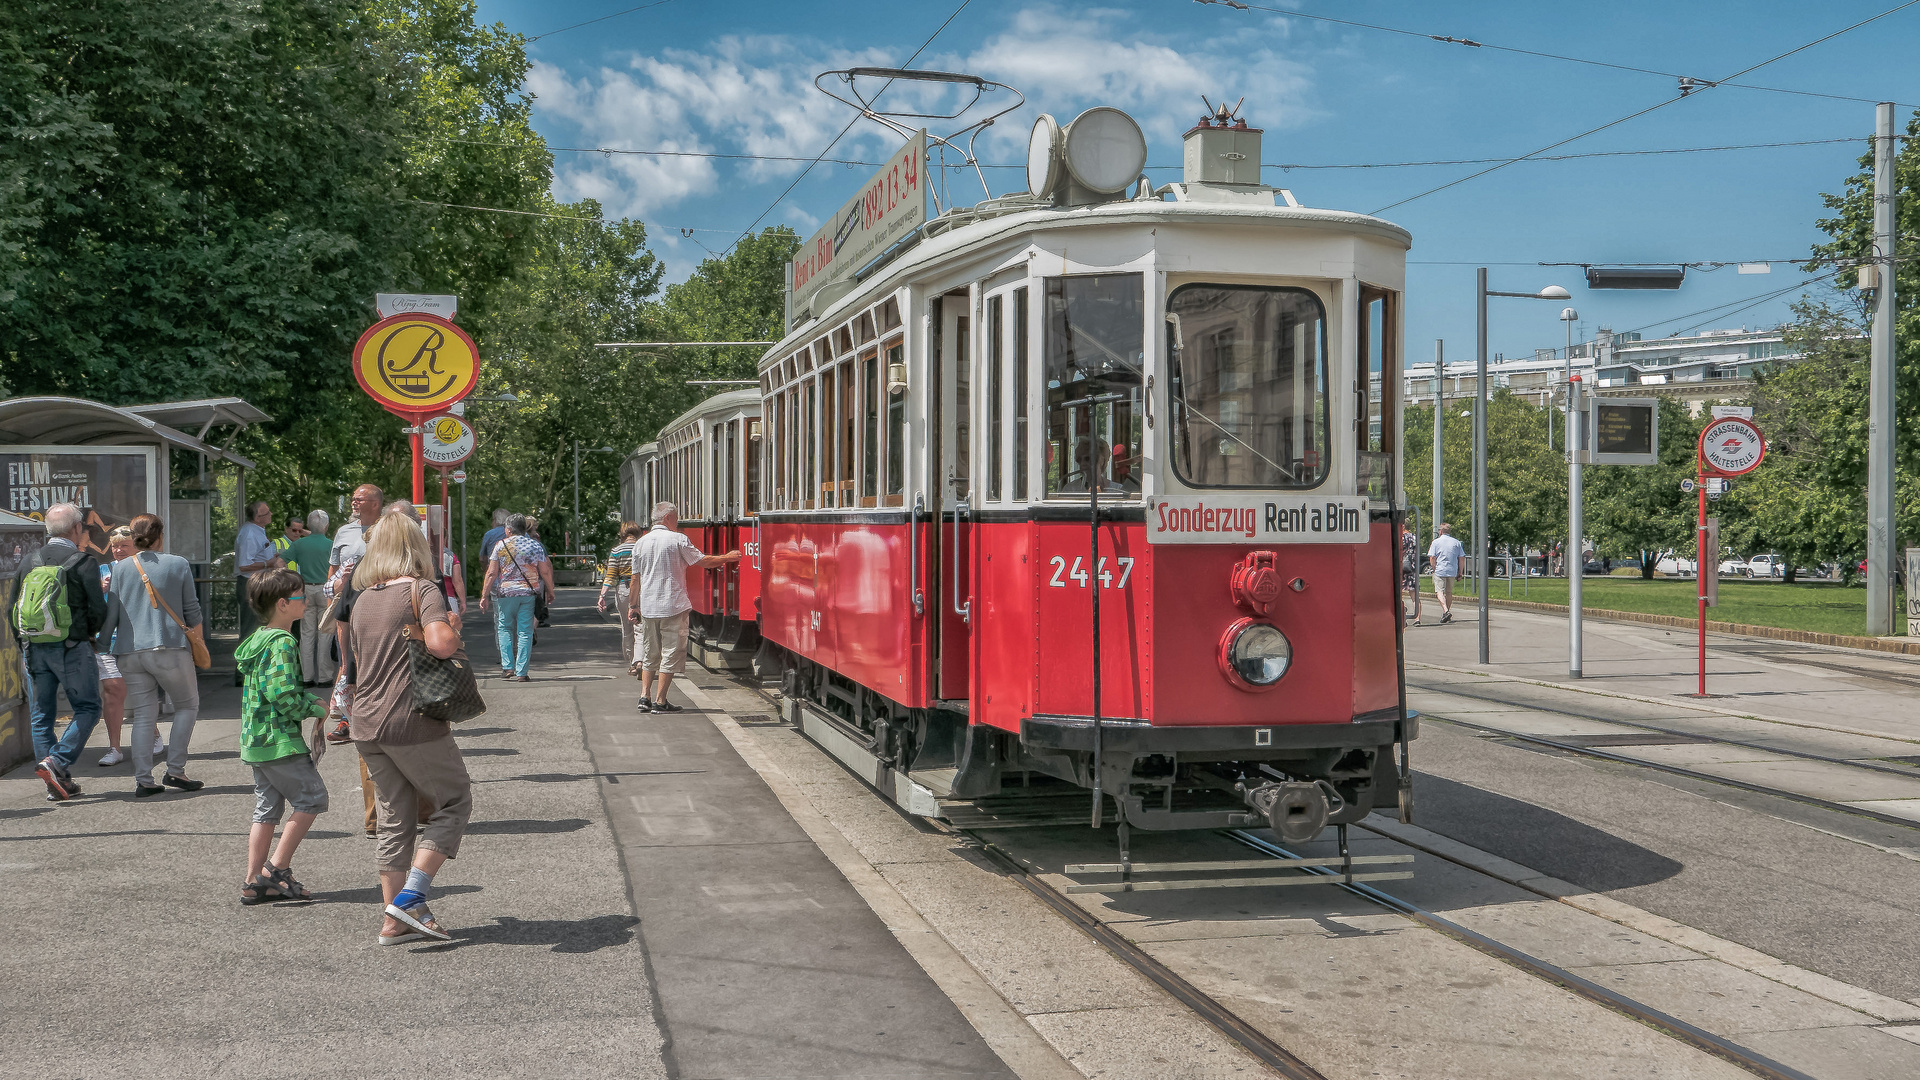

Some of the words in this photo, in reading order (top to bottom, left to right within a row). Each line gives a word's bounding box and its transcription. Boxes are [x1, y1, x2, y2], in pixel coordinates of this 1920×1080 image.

[795, 254, 809, 292] Rent
[811, 255, 815, 278] a
[817, 233, 833, 272] Bim
[865, 178, 883, 230] 892
[887, 165, 898, 213] 13
[902, 146, 917, 200] 34
[417, 298, 440, 308] Tram
[1707, 424, 1757, 444] STRASSENBAHN
[1709, 451, 1755, 468] HALTESTELLE
[9, 462, 50, 485] FILM
[1723, 481, 1728, 491] 1
[1157, 502, 1256, 538] Sonderzug
[1265, 502, 1307, 532] Rent
[1311, 508, 1321, 532] a
[1326, 502, 1360, 532] Bim
[1049, 555, 1135, 588] 2447
[810, 610, 821, 632] 2447
